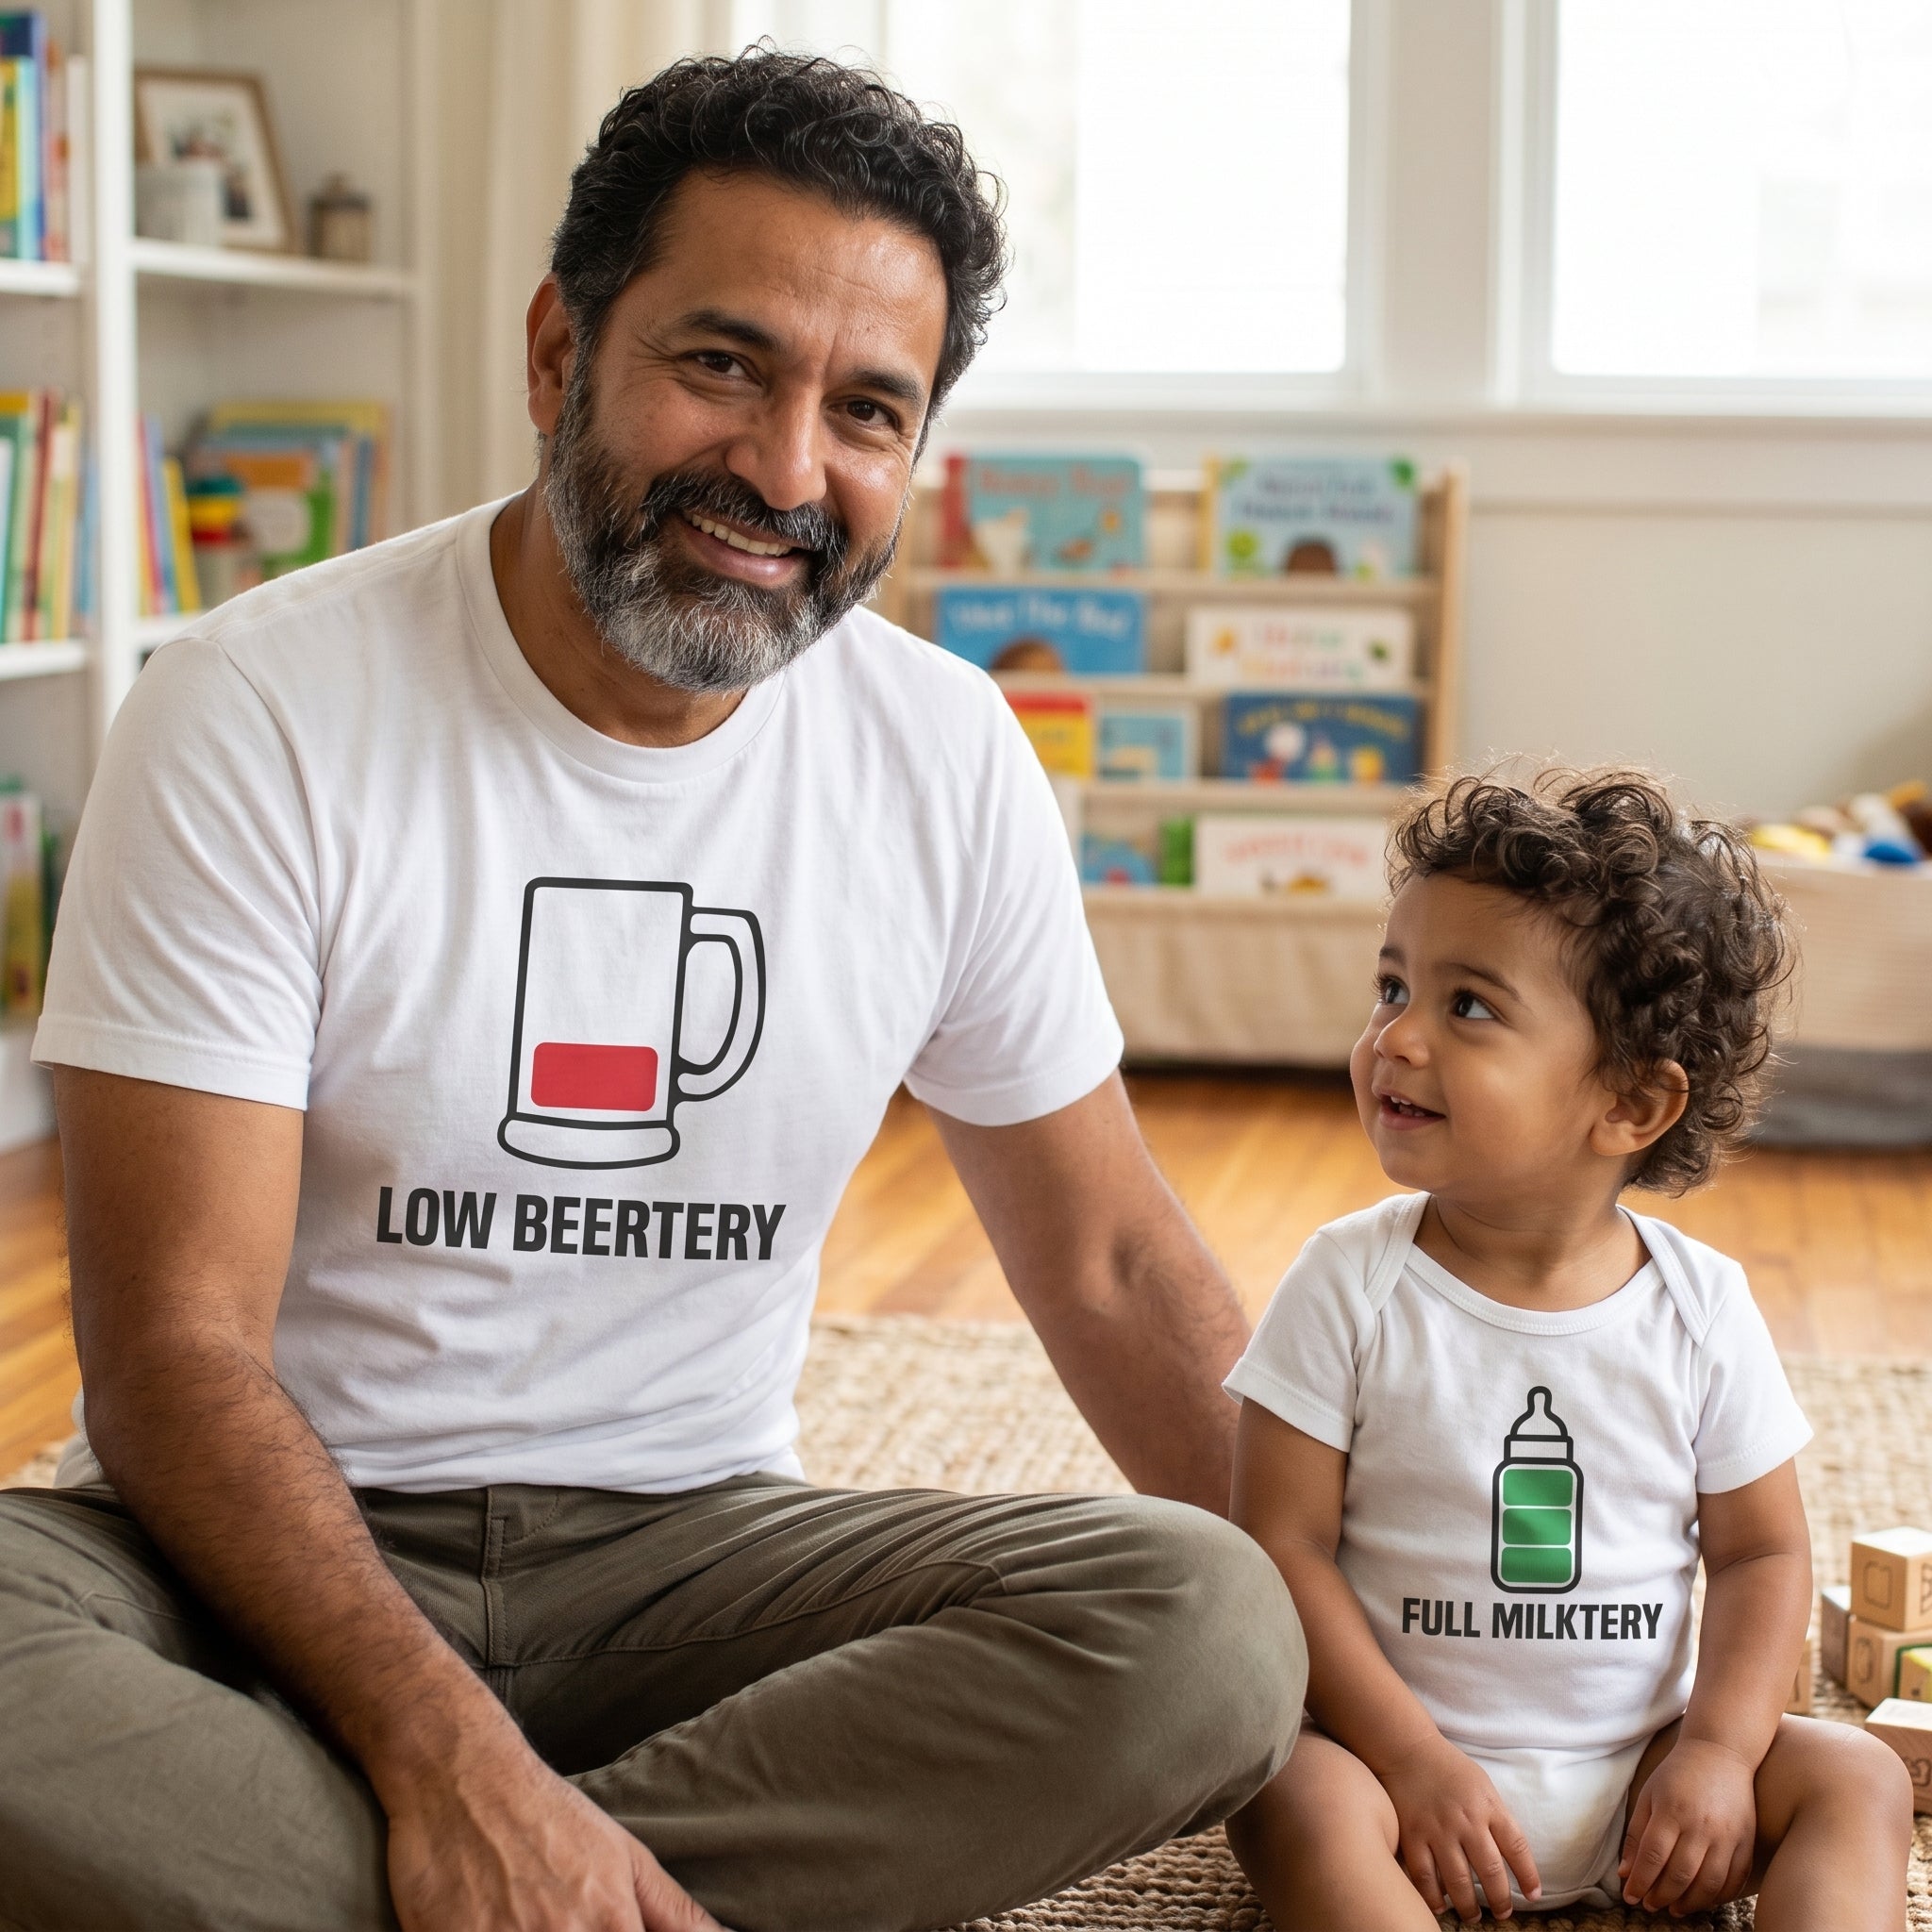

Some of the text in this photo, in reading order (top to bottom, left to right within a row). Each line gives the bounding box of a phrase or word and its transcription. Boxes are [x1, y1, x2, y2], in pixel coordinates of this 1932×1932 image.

[376, 1186, 787, 1260] LOW BEERTERY
[1402, 1597, 1663, 1640] FULL MILKTERY
